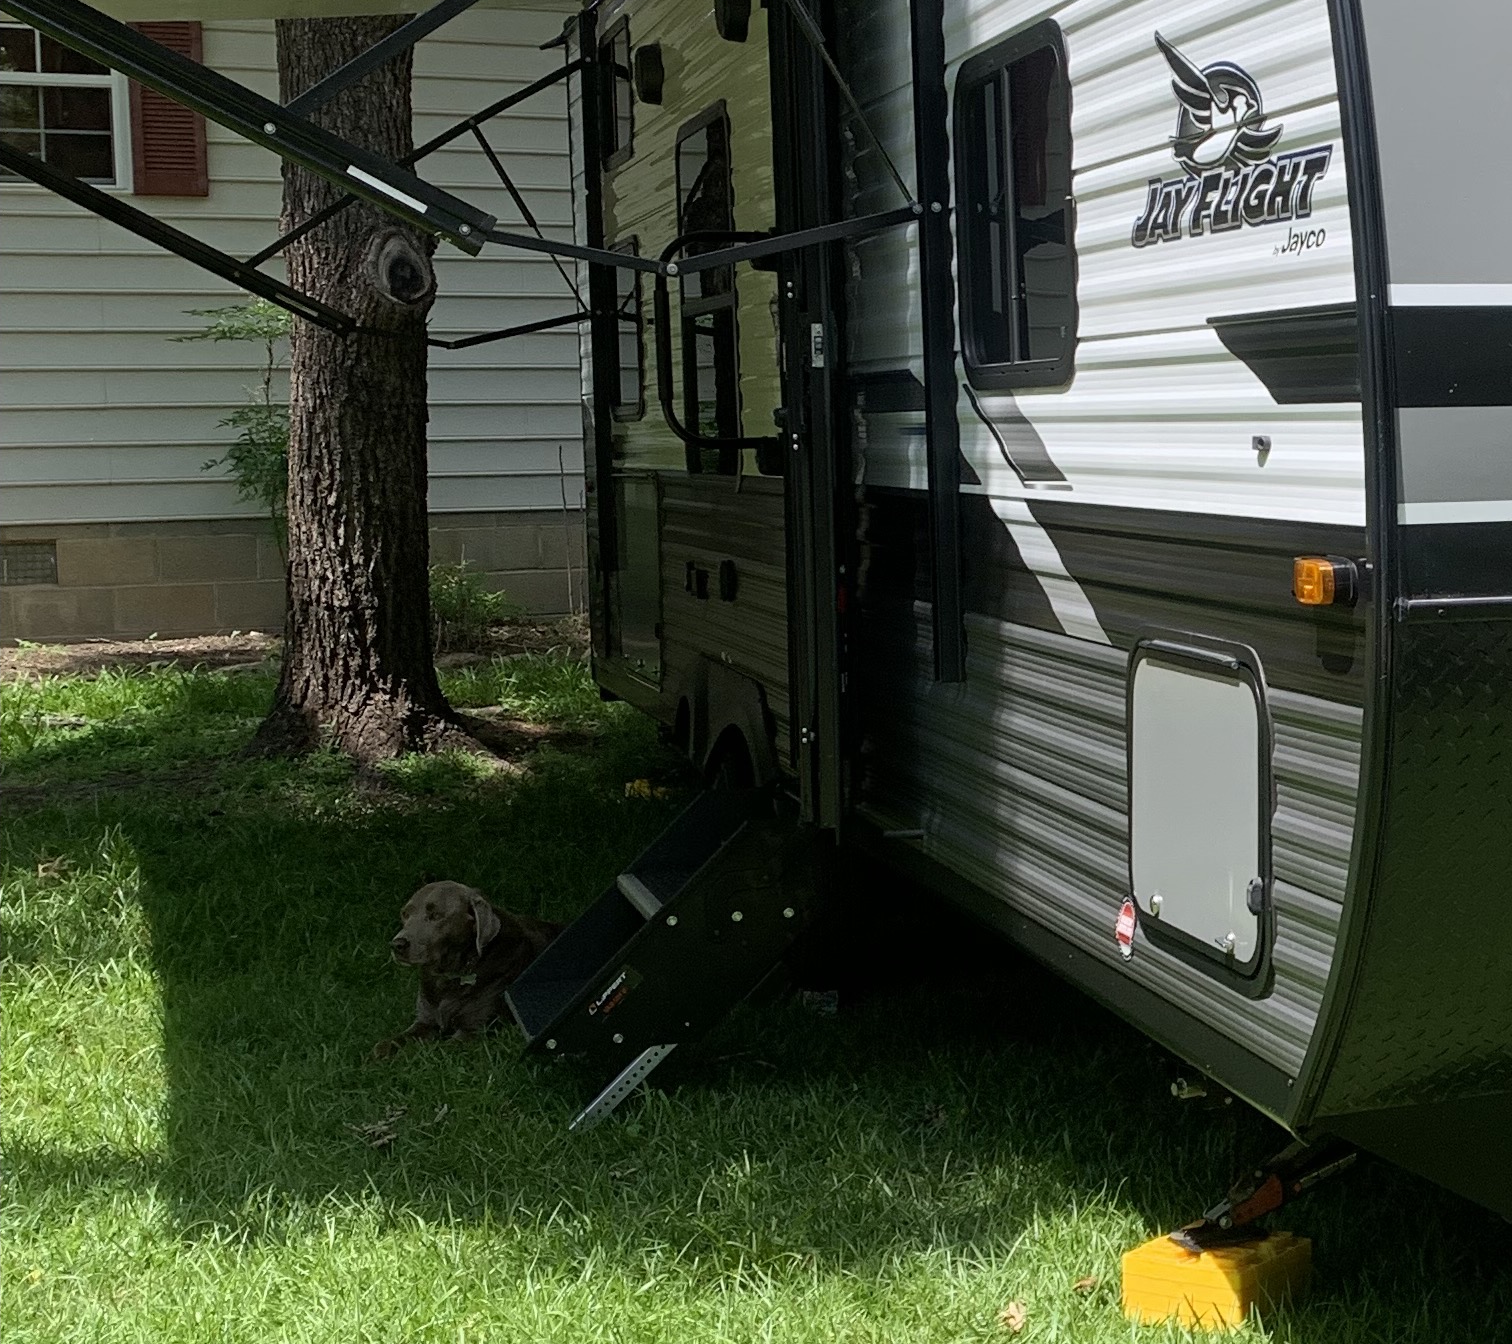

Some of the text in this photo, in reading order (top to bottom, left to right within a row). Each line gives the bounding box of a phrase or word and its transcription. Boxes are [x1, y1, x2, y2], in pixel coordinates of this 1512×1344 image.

[1131, 144, 1334, 248] JAY FLIGHT
[1281, 226, 1327, 257] Jayco
